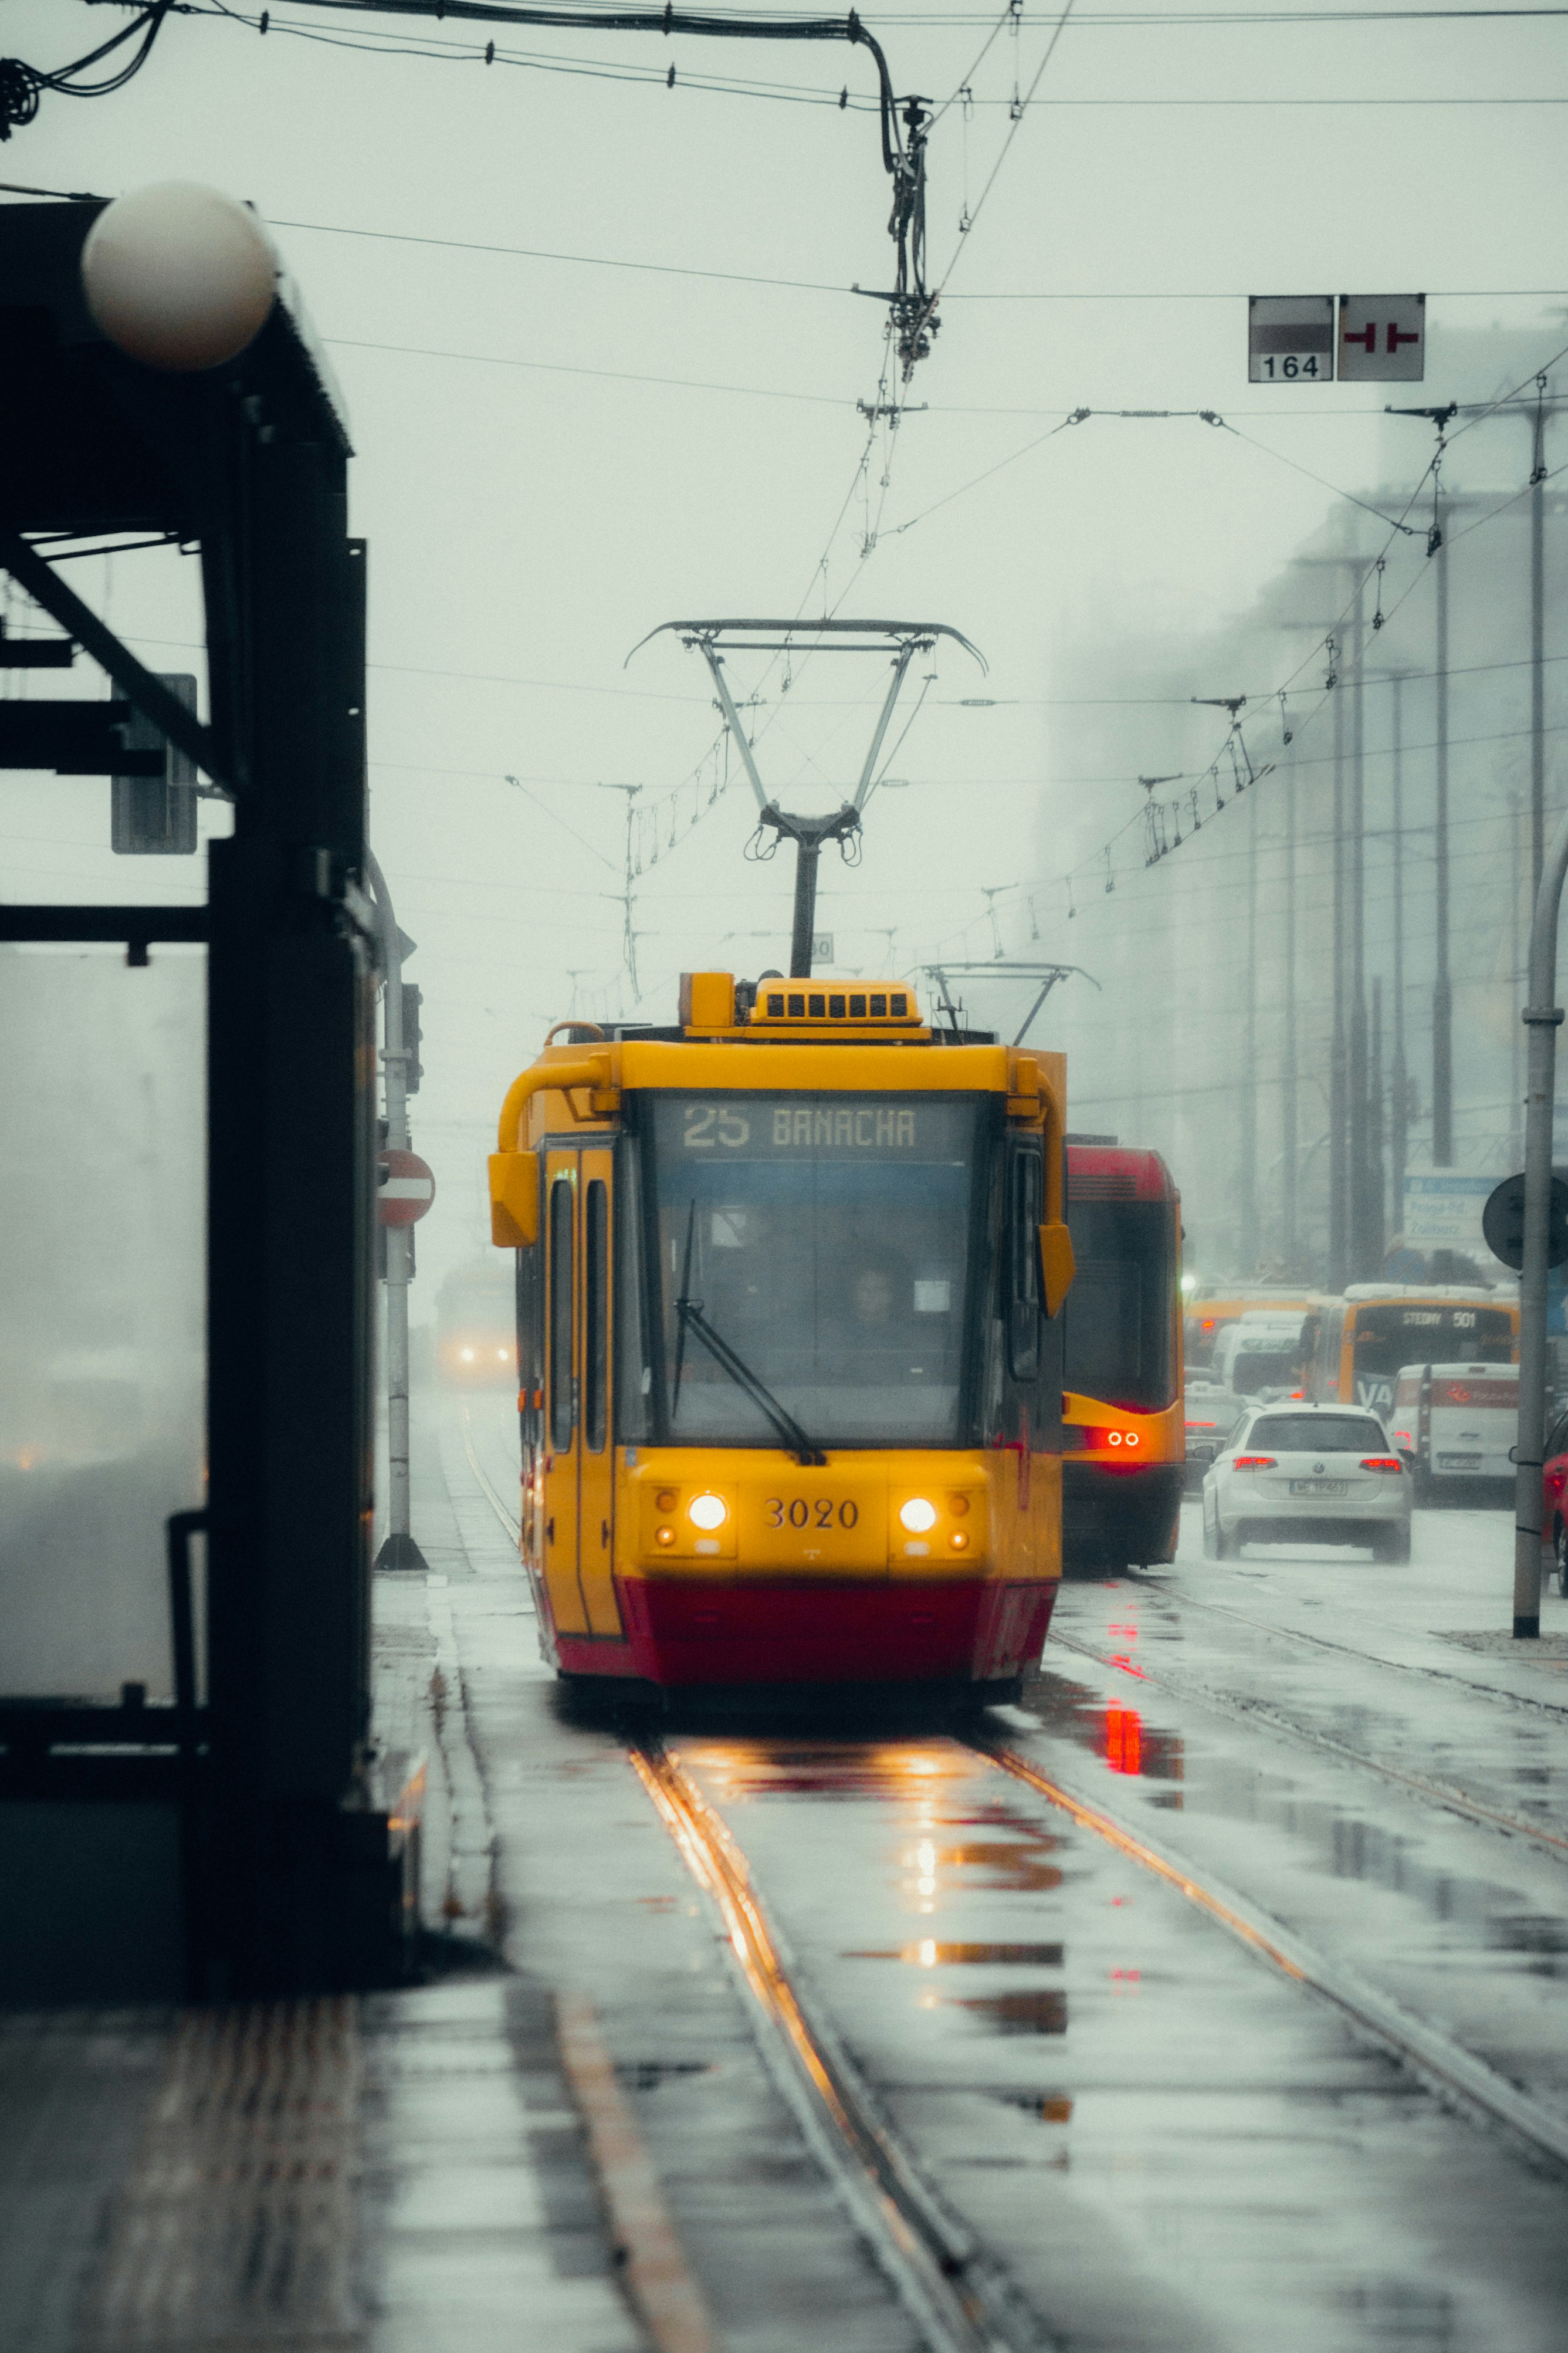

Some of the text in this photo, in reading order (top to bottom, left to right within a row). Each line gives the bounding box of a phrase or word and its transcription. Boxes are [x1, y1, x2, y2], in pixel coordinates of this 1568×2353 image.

[1264, 356, 1318, 377] 164
[684, 1107, 915, 1147] 25 BANACHA
[1453, 1311, 1476, 1328] 501
[765, 1499, 858, 1529] 3020
